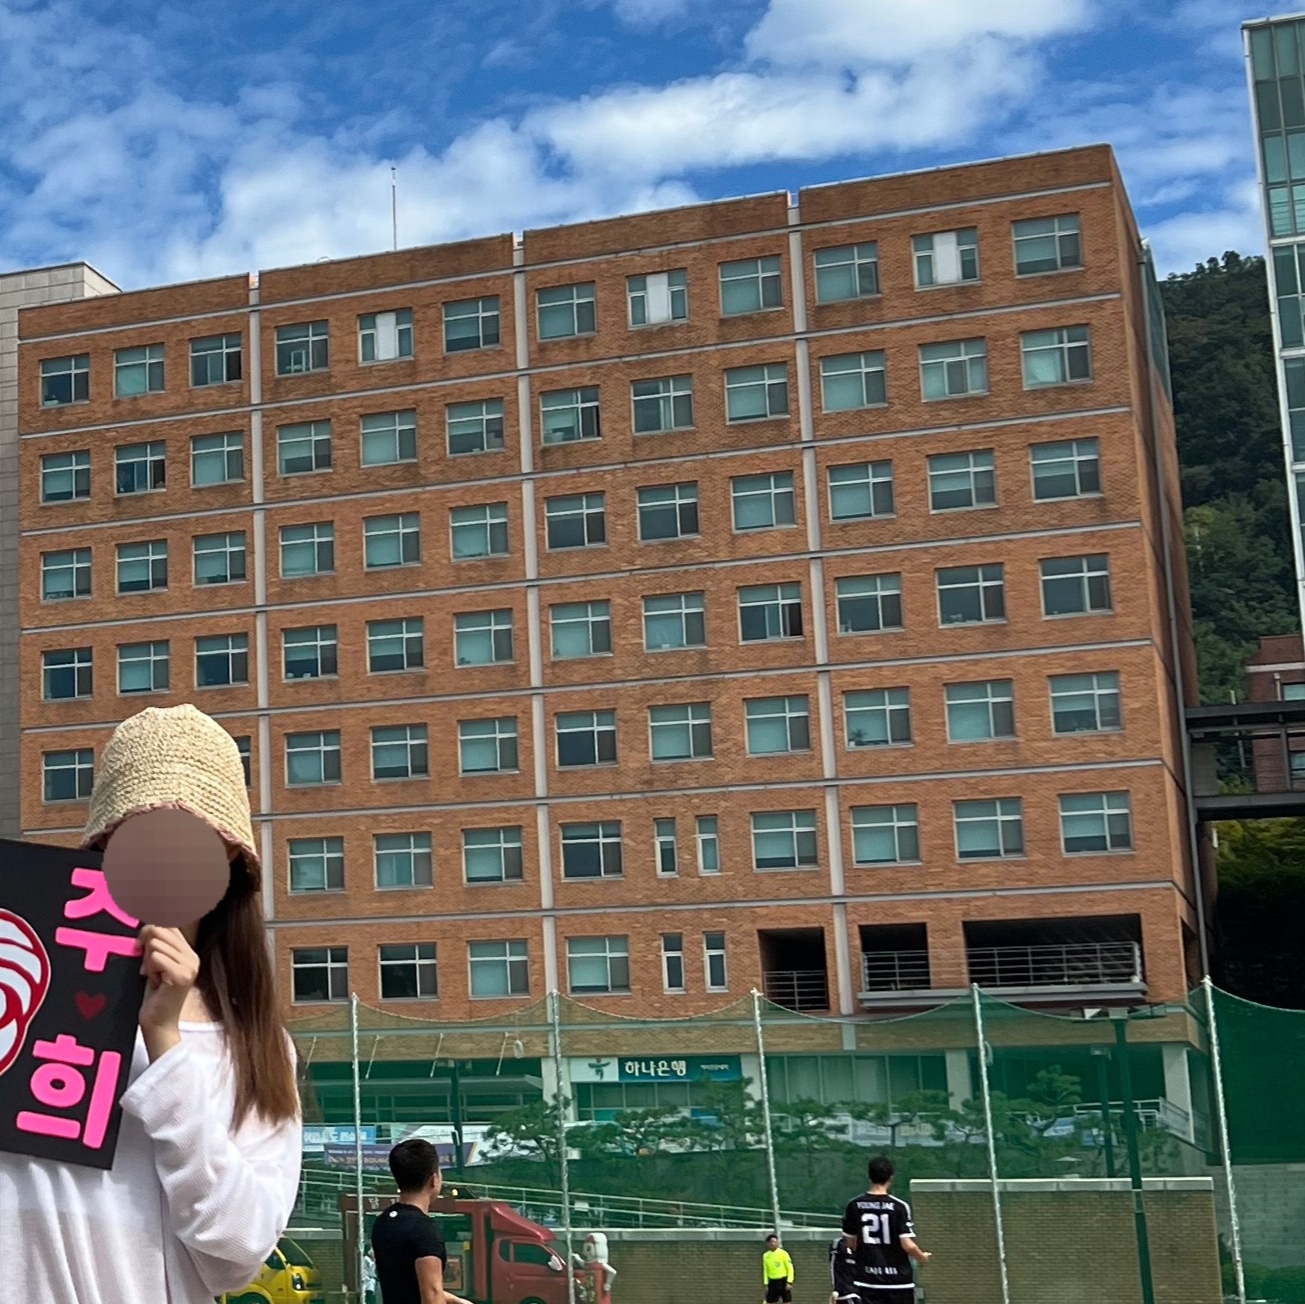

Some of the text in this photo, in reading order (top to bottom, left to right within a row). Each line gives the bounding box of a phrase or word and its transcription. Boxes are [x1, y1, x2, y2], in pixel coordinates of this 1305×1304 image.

[624, 1060, 687, 1077] 하나은행
[15, 1033, 122, 1150] 희
[861, 1213, 891, 1245] 21
